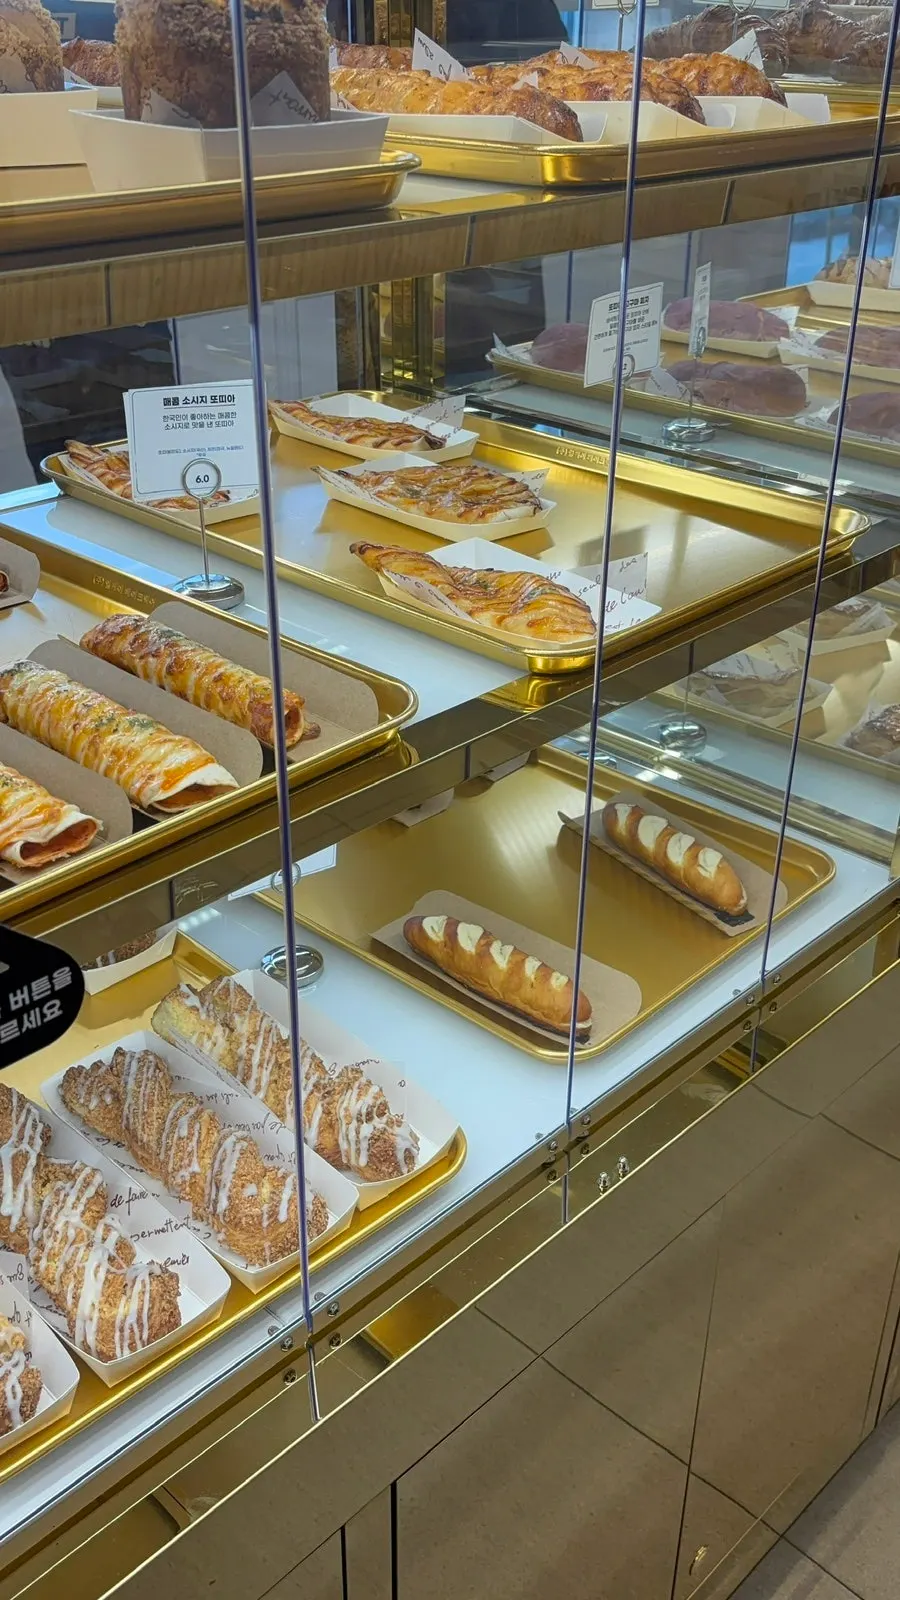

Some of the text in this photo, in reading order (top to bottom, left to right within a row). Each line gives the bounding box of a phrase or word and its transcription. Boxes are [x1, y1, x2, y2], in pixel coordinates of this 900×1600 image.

[163, 394, 235, 407] 매콤 소시지 또띠아
[162, 411, 237, 422] 한국인이 좋아하는 매콤한
[165, 422, 190, 431] 소시지로
[191, 421, 205, 429] 맛을
[215, 419, 234, 428] 또띠아
[195, 475, 210, 484] 6.0
[8, 966, 72, 1012] 버튼을
[110, 1194, 124, 1208] de
